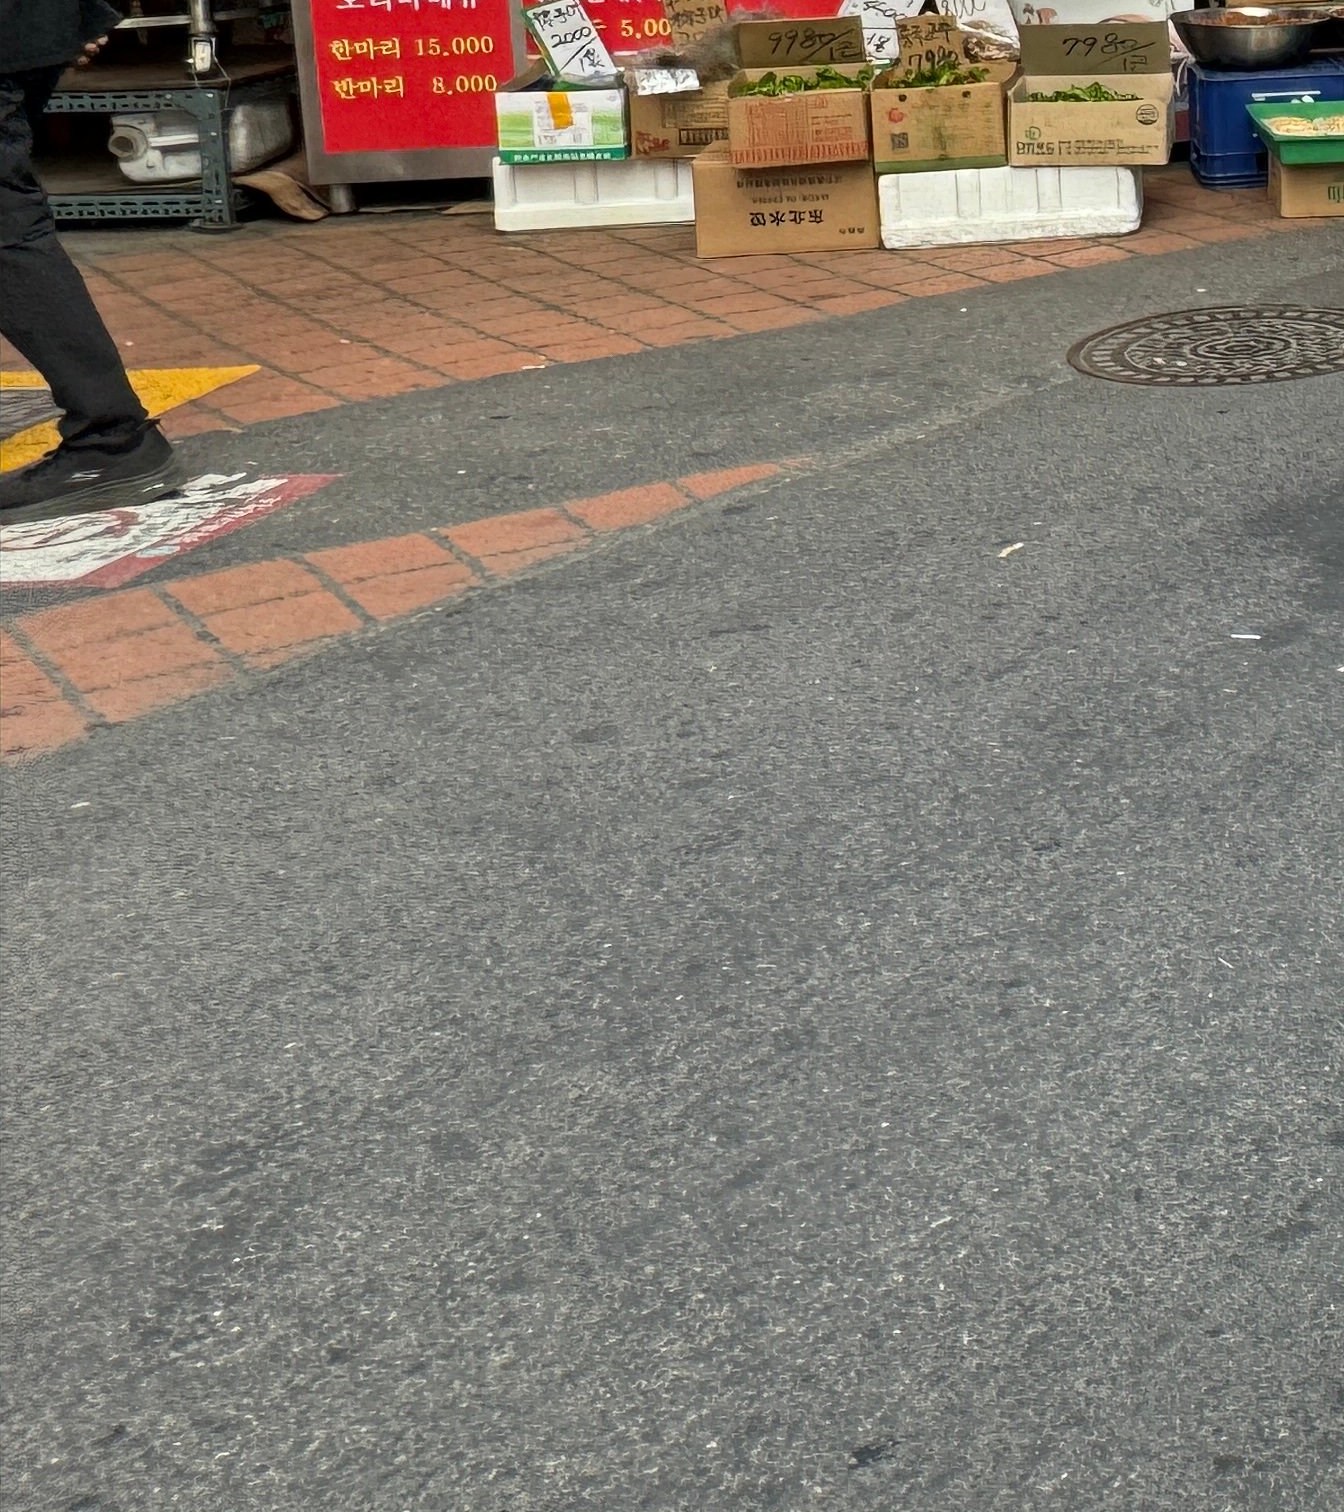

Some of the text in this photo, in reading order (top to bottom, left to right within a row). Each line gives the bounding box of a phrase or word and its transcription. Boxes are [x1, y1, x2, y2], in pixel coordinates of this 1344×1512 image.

[620, 18, 673, 39] 5.00
[331, 36, 402, 62] 한마리
[332, 75, 404, 100] 반마리
